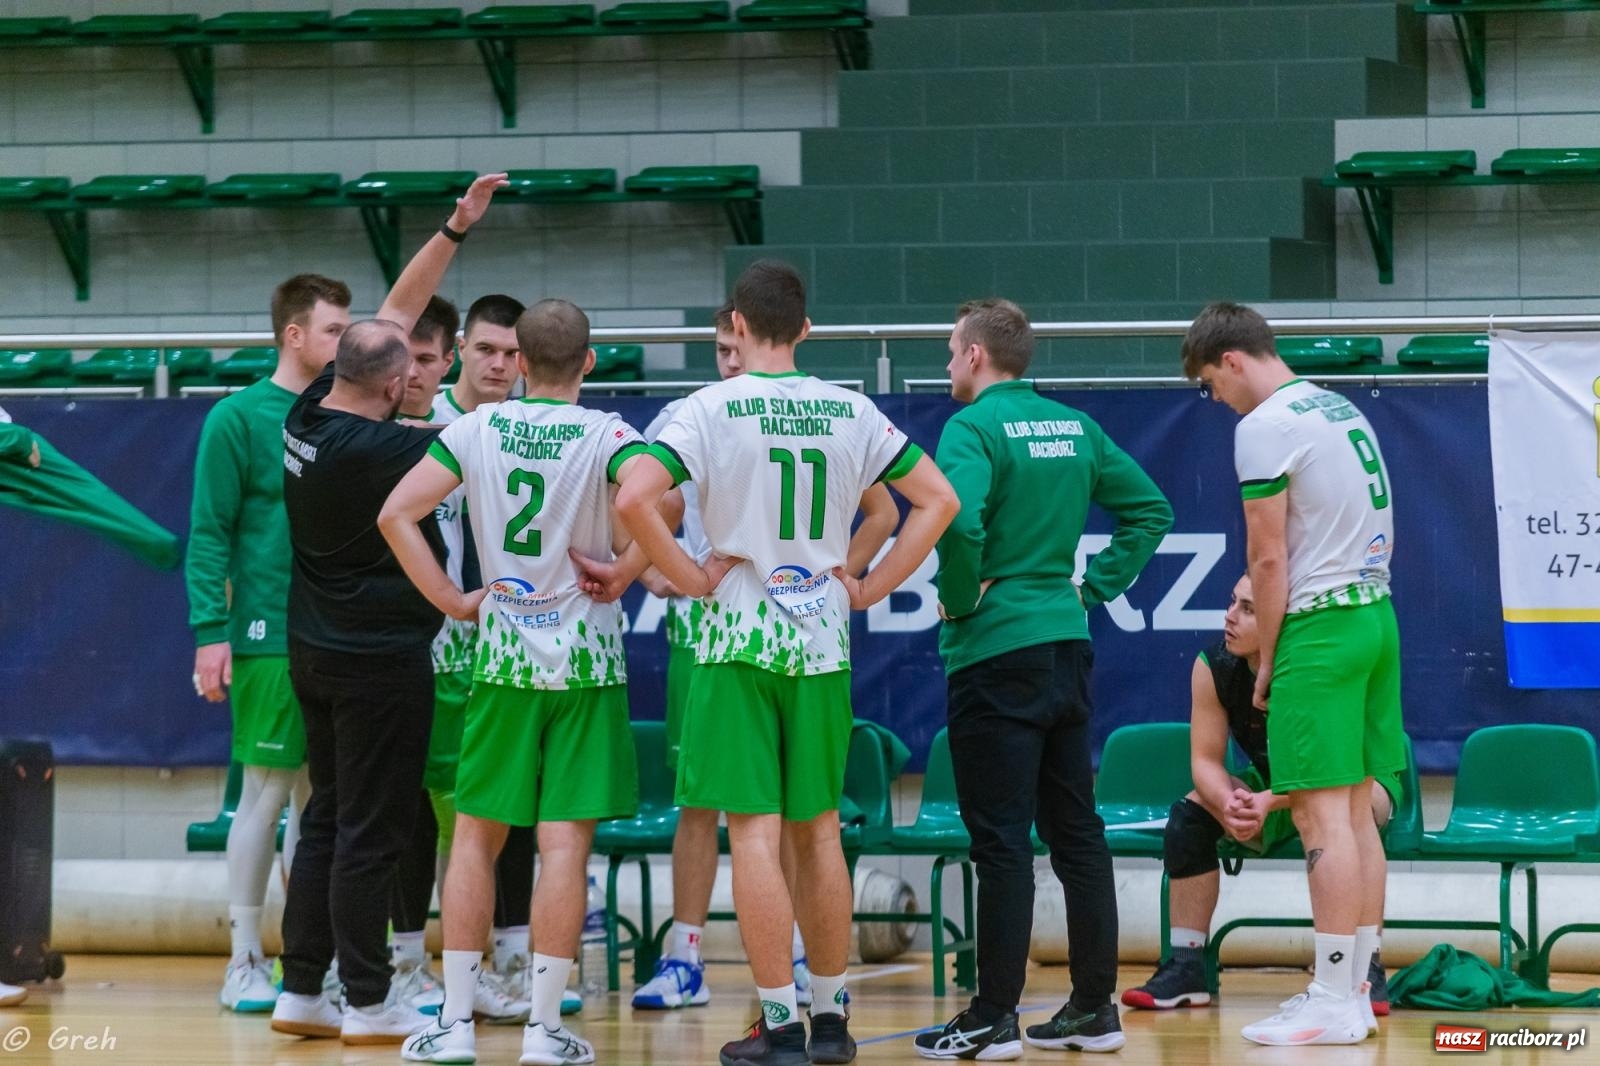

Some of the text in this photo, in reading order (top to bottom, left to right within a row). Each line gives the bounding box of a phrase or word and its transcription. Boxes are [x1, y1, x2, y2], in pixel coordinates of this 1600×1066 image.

[726, 397, 855, 419] KLUB SIATKARSKI
[760, 415, 833, 436] RACIBÓRZ
[1003, 421, 1032, 438] KLUB
[1028, 438, 1077, 458] RACIBÓRZ
[1347, 428, 1389, 510] 9
[769, 447, 827, 540] 11
[503, 467, 545, 557] 2
[1526, 510, 1567, 535] tel.
[247, 619, 266, 640] 49
